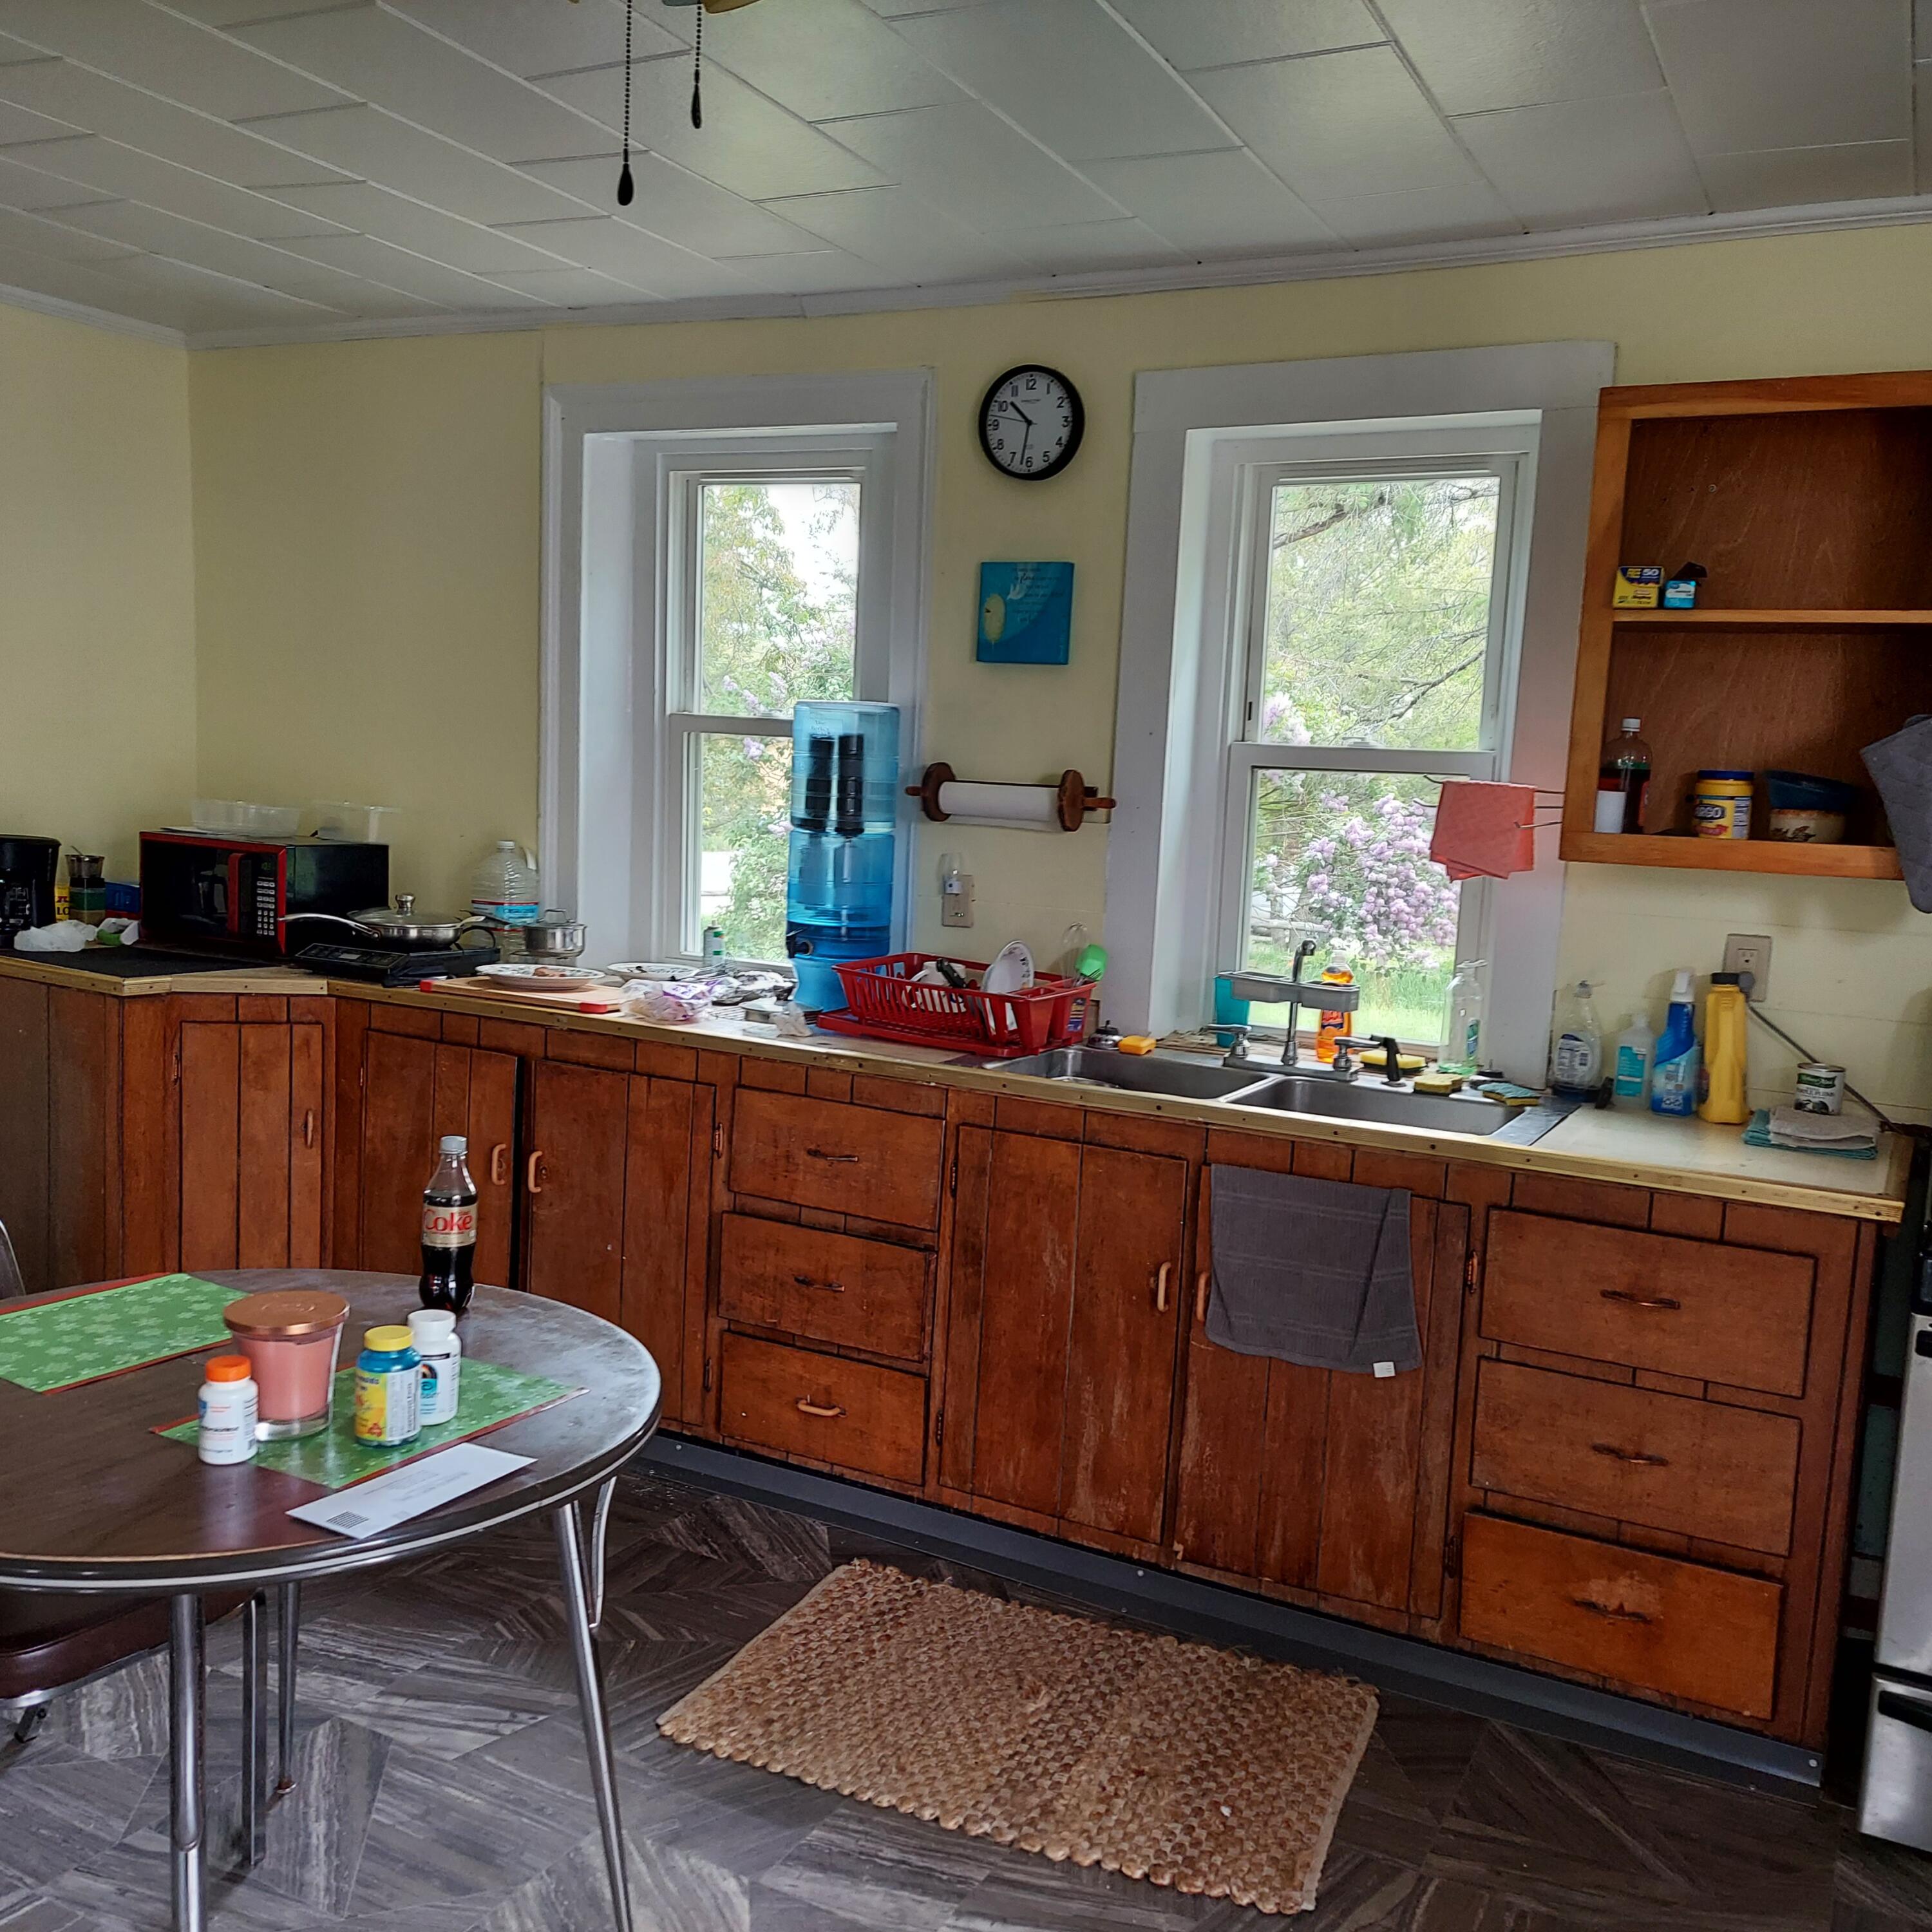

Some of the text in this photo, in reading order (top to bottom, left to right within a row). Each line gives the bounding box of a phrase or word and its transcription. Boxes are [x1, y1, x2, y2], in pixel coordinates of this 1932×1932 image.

[1025, 378, 1037, 390] 12
[1046, 383, 1051, 395] 1
[1011, 384, 1019, 397] 11
[998, 400, 1009, 412] 10
[1056, 396, 1064, 408] 2
[992, 419, 999, 431] 9
[1061, 415, 1070, 428] 3
[996, 438, 1005, 450] 8
[1055, 436, 1063, 448] 4
[1009, 451, 1017, 463] 7
[1025, 456, 1034, 468] 6
[1042, 451, 1050, 462] 5
[1642, 568, 1660, 576] 50
[423, 1209, 473, 1232] Coke
